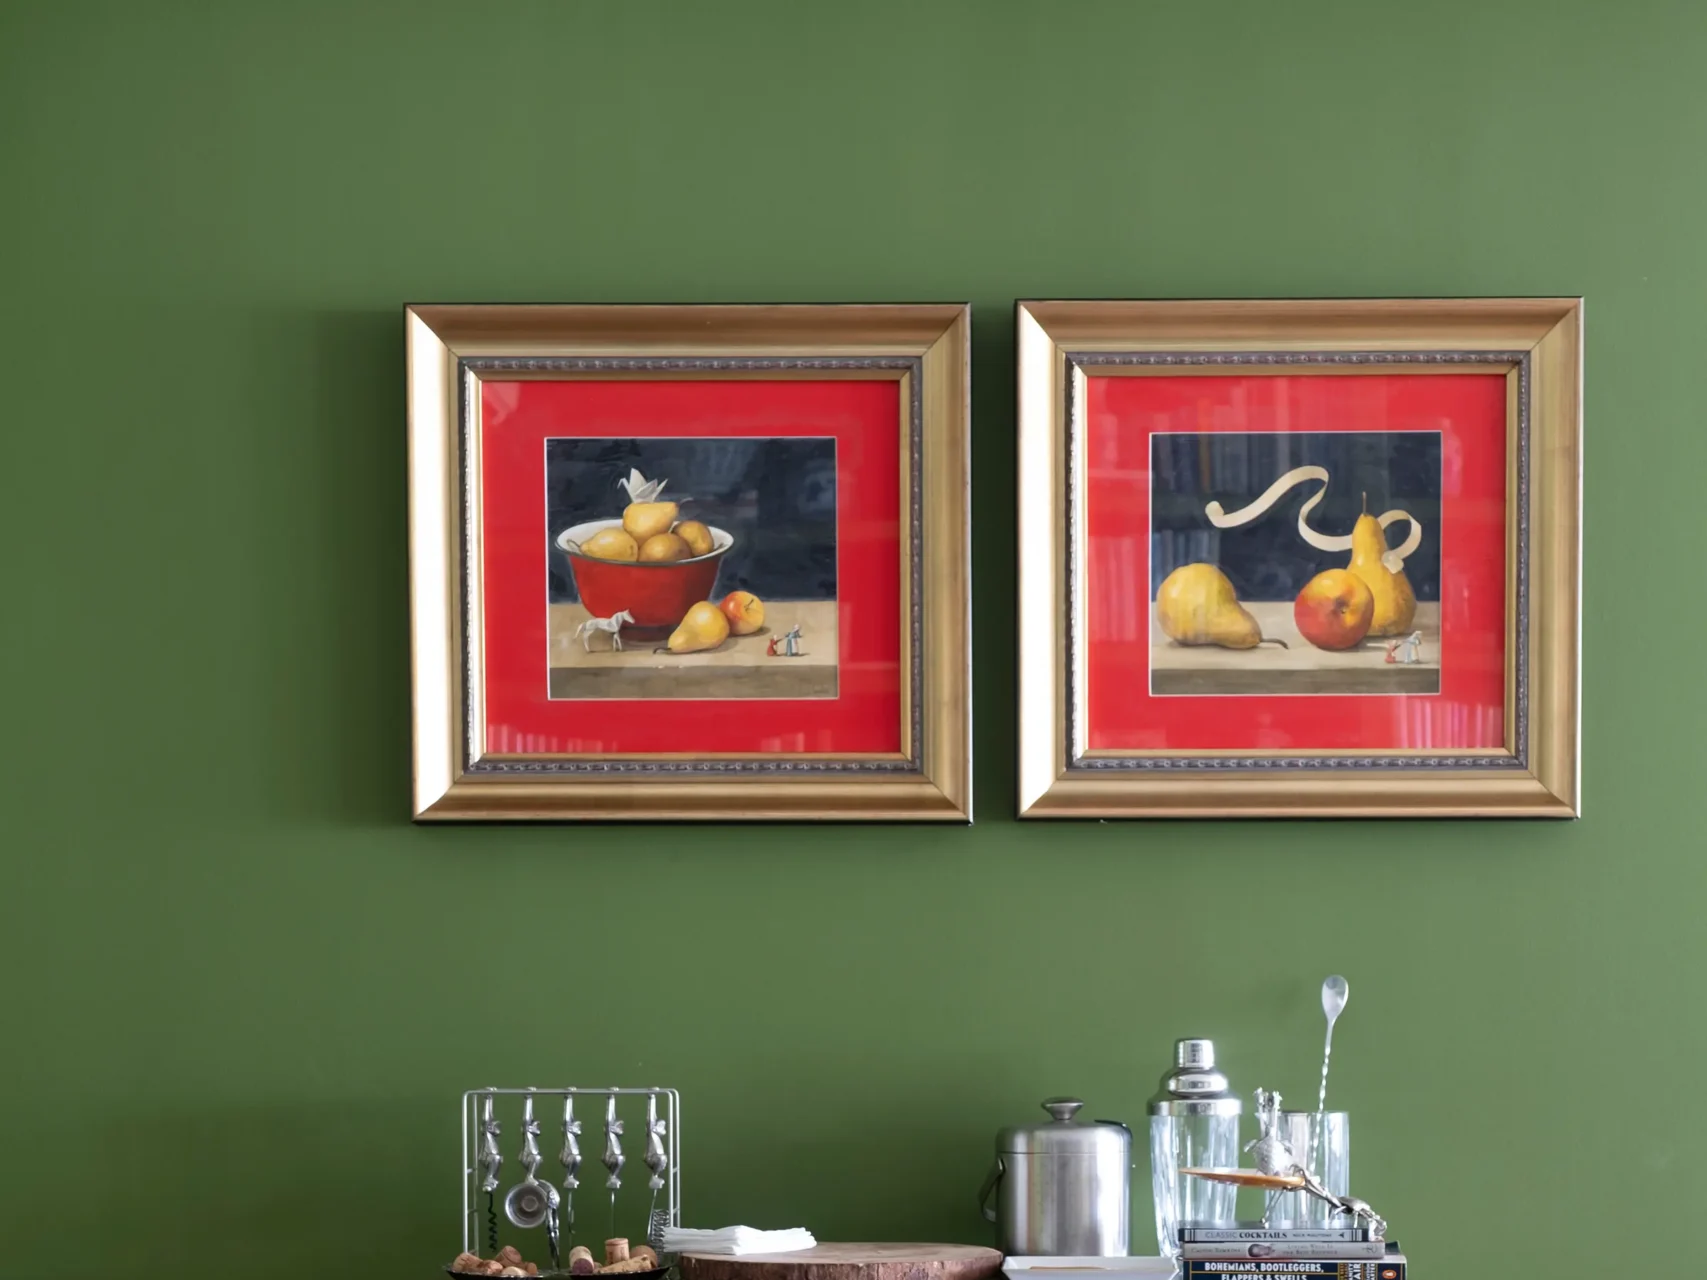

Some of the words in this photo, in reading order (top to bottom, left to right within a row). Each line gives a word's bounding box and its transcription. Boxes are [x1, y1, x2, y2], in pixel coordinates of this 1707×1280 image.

[1205, 1231, 1237, 1239] CLASSIC
[1239, 1231, 1287, 1239] COCKTAILS
[1204, 1262, 1259, 1272] BOHEMIANS,
[1260, 1262, 1324, 1273] BOOTLEGGERS,
